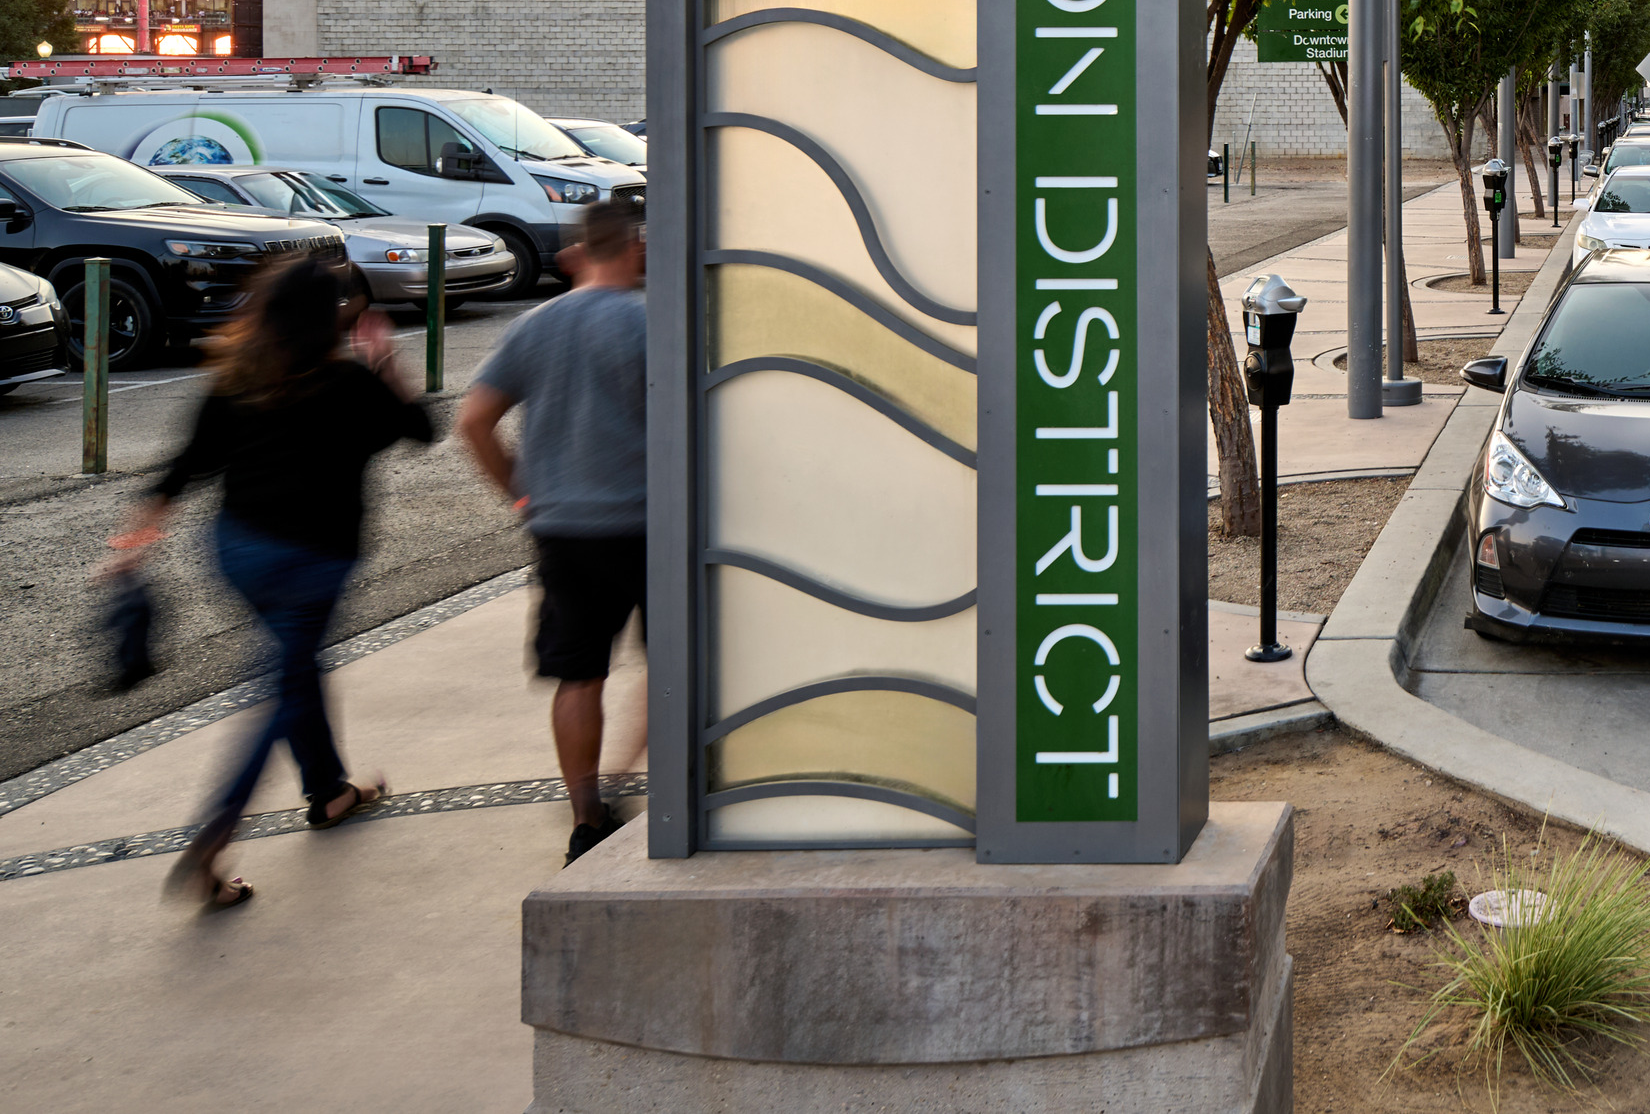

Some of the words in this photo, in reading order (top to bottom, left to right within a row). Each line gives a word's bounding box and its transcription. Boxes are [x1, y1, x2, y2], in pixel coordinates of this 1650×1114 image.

[1288, 8, 1332, 22] Parking
[1293, 34, 1348, 46] Downtow
[1034, 176, 1121, 798] DISTRICT
